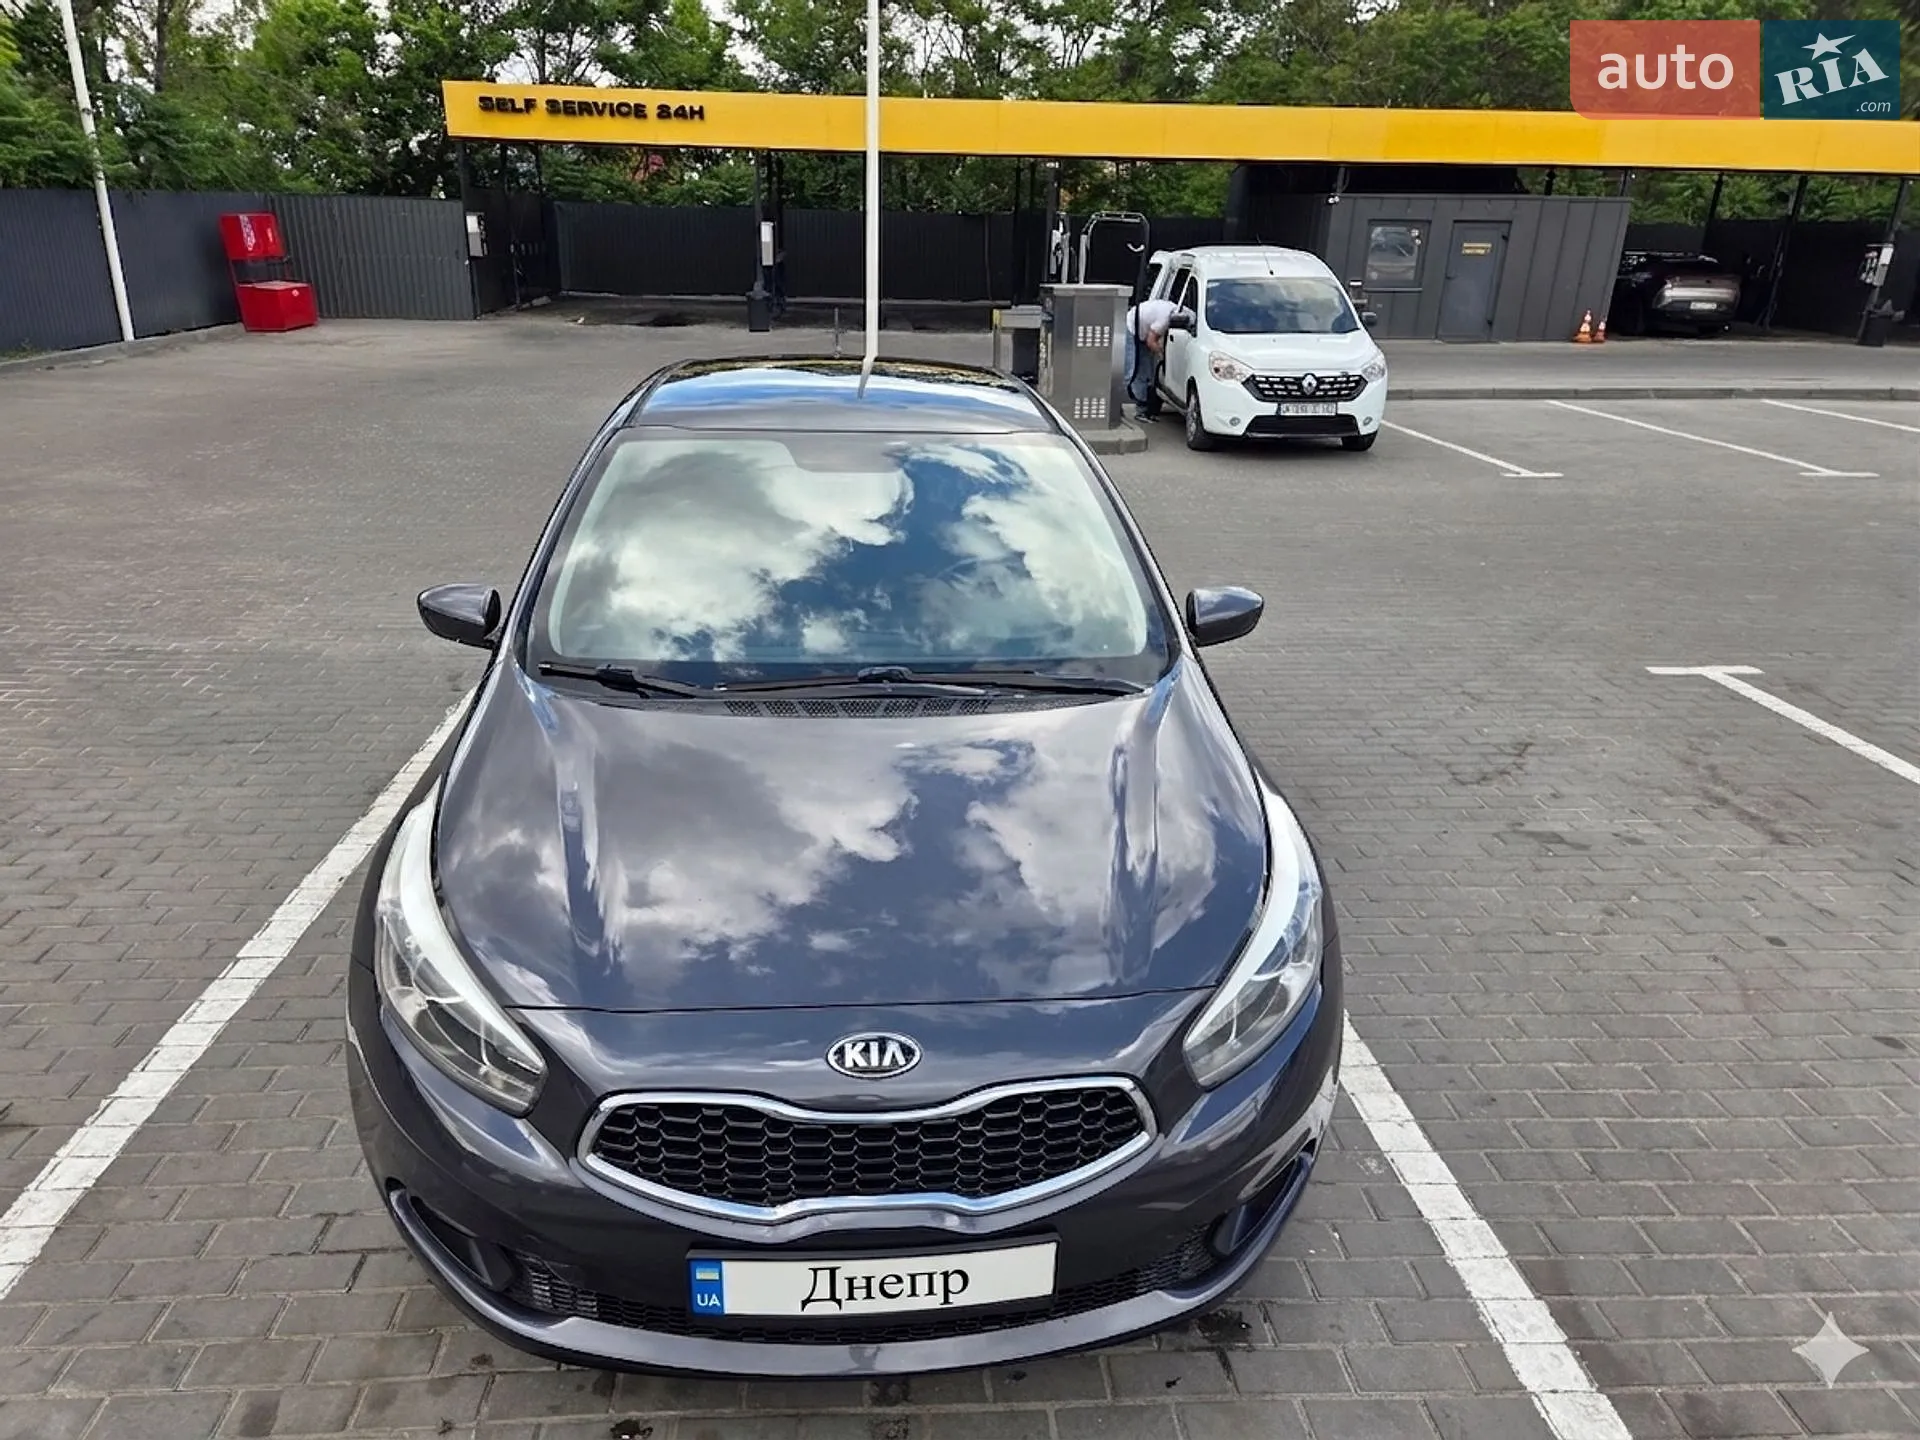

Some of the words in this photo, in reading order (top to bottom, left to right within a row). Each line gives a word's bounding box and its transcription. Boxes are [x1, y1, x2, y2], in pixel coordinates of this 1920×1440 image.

[478, 96, 537, 114] SELF
[545, 98, 648, 120] SERVICE
[656, 104, 705, 121] 24H
[844, 1040, 906, 1068] KIA
[697, 1294, 721, 1308] UA
[800, 1266, 970, 1312] Днепр
